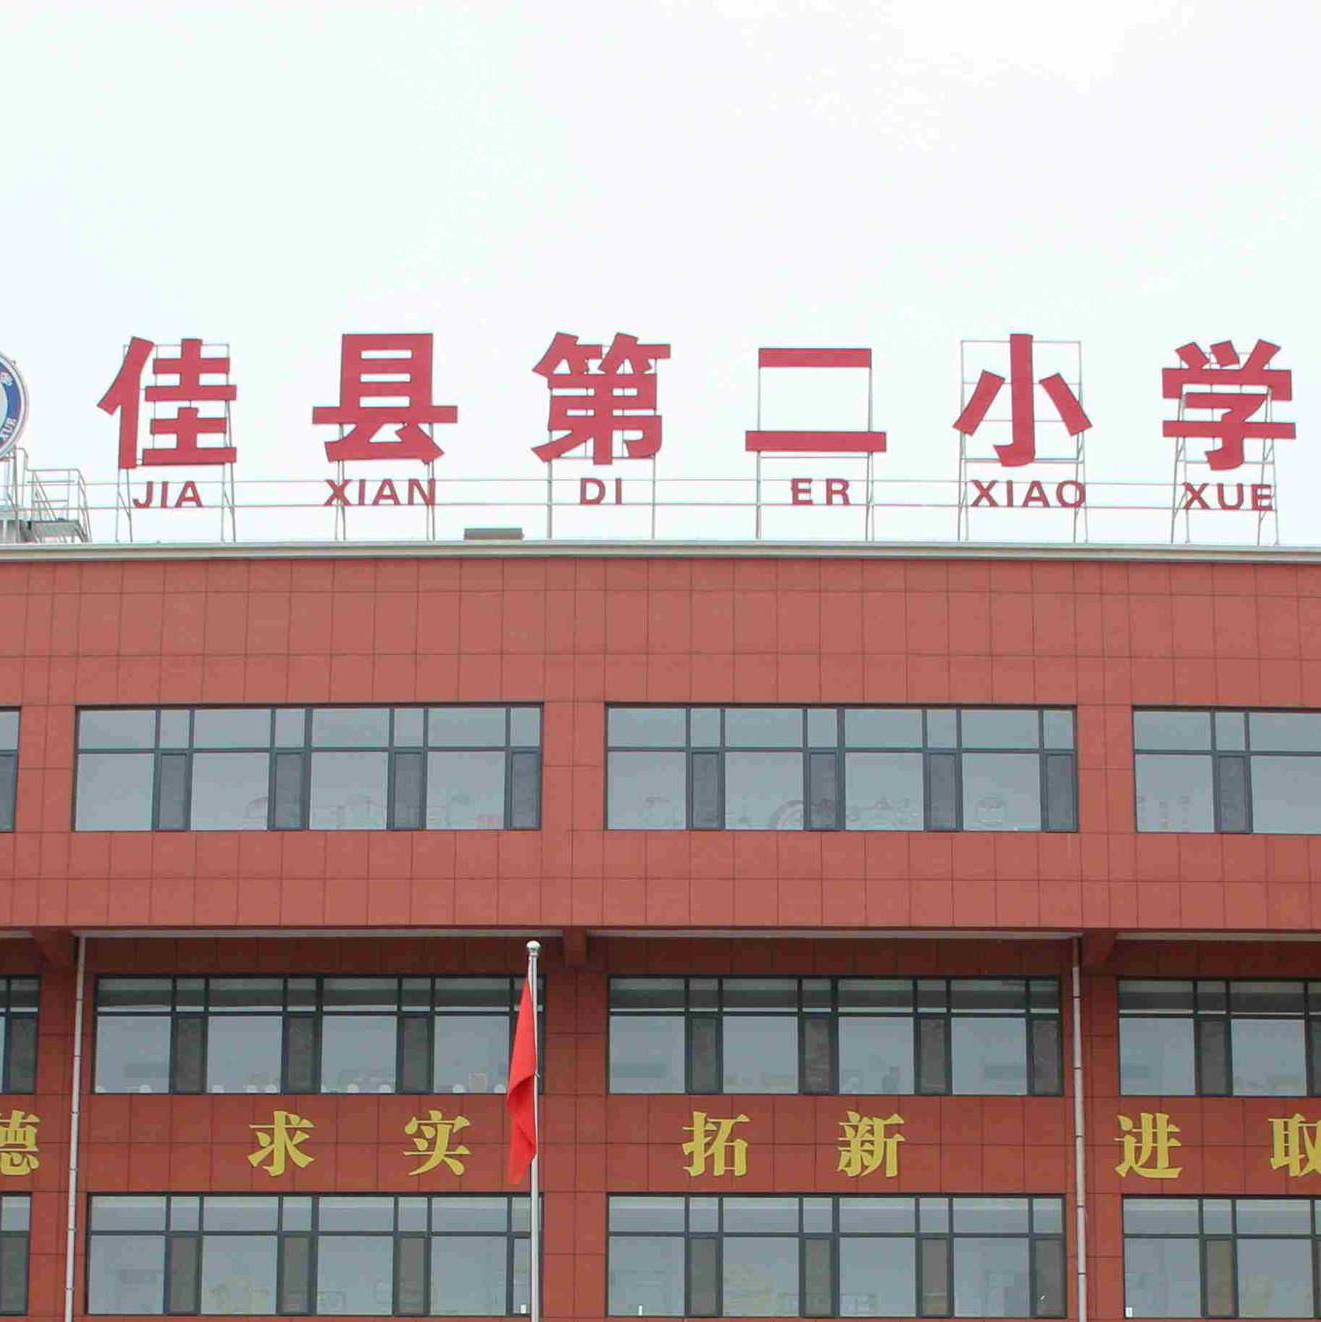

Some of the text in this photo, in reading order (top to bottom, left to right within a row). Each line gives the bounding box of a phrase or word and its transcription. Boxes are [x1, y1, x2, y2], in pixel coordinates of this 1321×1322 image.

[99, 333, 1295, 474] 佳县第二小学
[132, 479, 1275, 512] JIA XIAN DI ER XIAO XUE
[247, 1109, 472, 1177] 求实
[681, 1110, 906, 1178] 拓新
